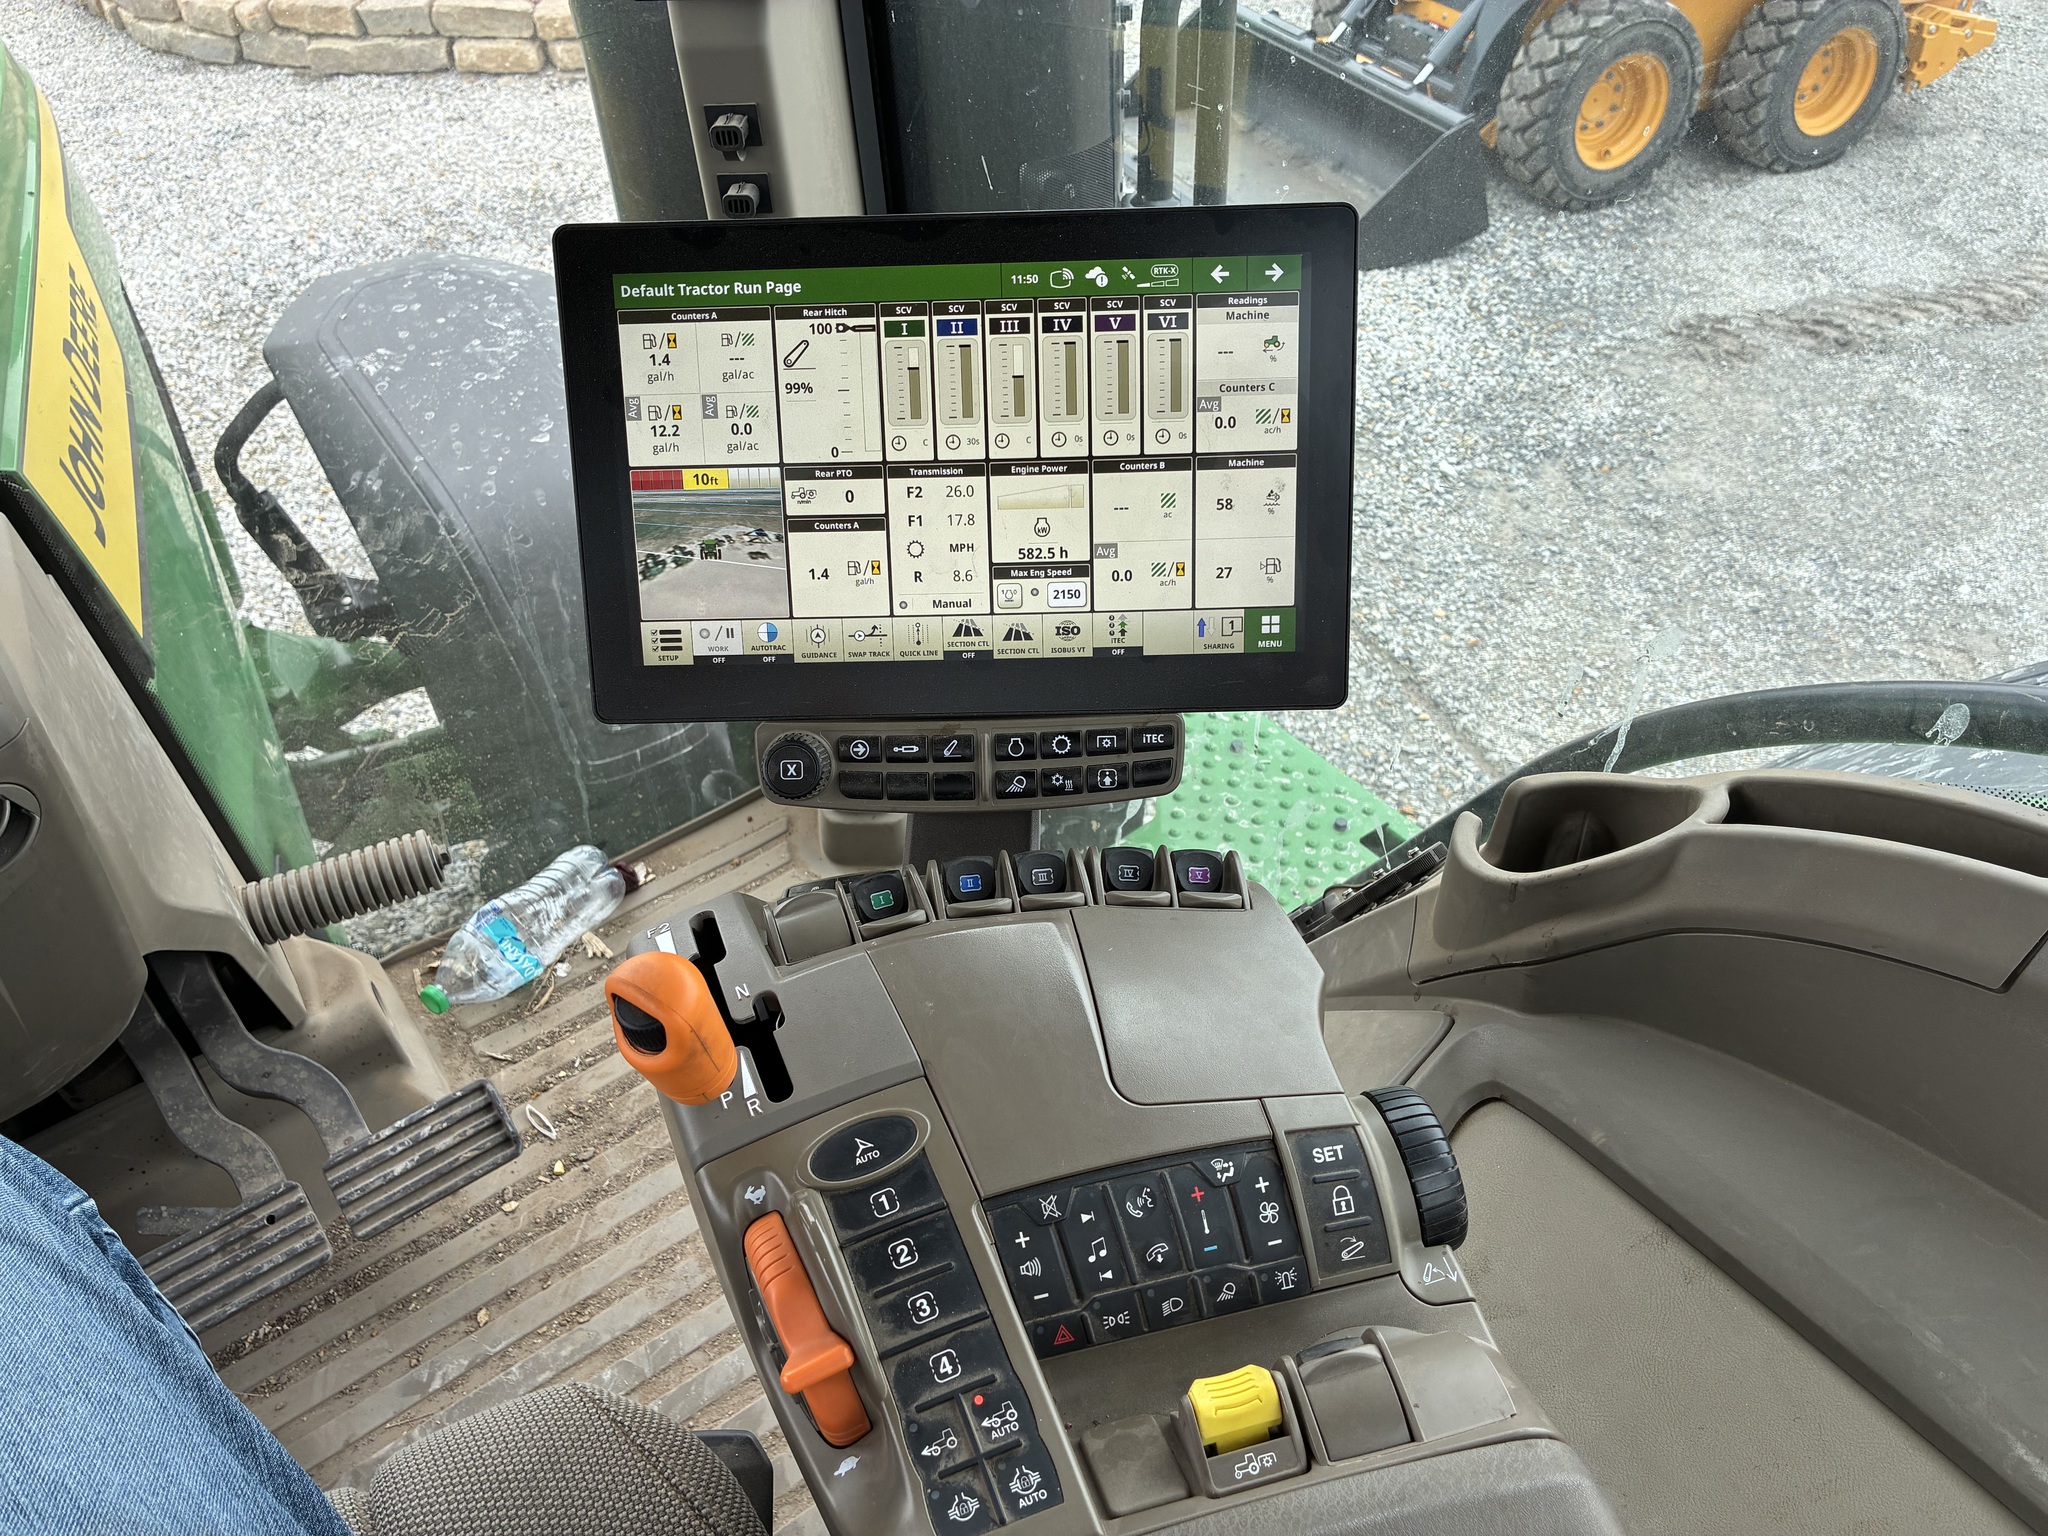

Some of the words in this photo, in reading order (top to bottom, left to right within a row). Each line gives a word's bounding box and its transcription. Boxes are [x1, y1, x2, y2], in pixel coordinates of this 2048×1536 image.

[1153, 266, 1176, 275] RTK-X
[1011, 275, 1039, 284] 11:50
[621, 284, 675, 297] Default
[678, 283, 730, 296] Tractor
[734, 282, 762, 294] Run
[766, 281, 802, 296] Page
[1001, 303, 1018, 311] SCV
[1054, 302, 1071, 310] SCV
[1107, 300, 1124, 308] SCV
[1160, 299, 1177, 307] SCV
[1228, 296, 1268, 306] Readings
[803, 308, 822, 317] Rear
[824, 307, 848, 316] Hitch
[896, 306, 912, 314] SCV
[948, 305, 965, 313] SCV
[671, 311, 708, 321] Counters
[710, 312, 718, 320] A
[1159, 315, 1178, 328] VI
[1226, 310, 1270, 321] Machine
[809, 323, 832, 335] 100
[901, 323, 908, 335] I
[951, 321, 964, 334] II
[1000, 320, 1020, 333] III
[1053, 318, 1072, 331] IV
[1109, 317, 1122, 329] V
[62, 262, 102, 414] DEERE
[649, 354, 671, 366] 1.4
[647, 371, 675, 385] gal/h
[722, 369, 755, 383] gal/ac
[785, 382, 814, 394] 99%
[1219, 383, 1266, 393] Counters
[1269, 382, 1276, 391] C
[627, 396, 639, 418] Avg
[704, 395, 716, 417] Avg
[1199, 399, 1219, 411] Avg
[1215, 416, 1236, 429] 0.0
[651, 425, 680, 437] 12.2
[731, 423, 753, 436] 0.0
[1264, 426, 1281, 434] ac/h
[967, 437, 980, 445] 30s
[1074, 434, 1083, 443] 0s
[1126, 433, 1135, 441] 0s
[1178, 432, 1187, 440] 0s
[652, 442, 680, 456] gal/h
[727, 440, 759, 454] gal/ac
[831, 447, 839, 458] 0
[59, 376, 106, 549] JOHN
[1120, 462, 1158, 471] Counters
[1229, 458, 1264, 467] Machine
[815, 469, 833, 478] Rear
[835, 469, 853, 477] PTO
[910, 467, 963, 476] Transmission
[1011, 466, 1039, 475] Engine
[1041, 465, 1068, 473] Power
[845, 490, 854, 503] 0
[907, 486, 923, 498] F2
[946, 484, 974, 498] 26.0
[1216, 498, 1233, 511] 58
[814, 521, 851, 531] Counters
[853, 522, 860, 530] A
[908, 515, 923, 527] F1
[947, 514, 975, 526] 17.8
[1037, 526, 1048, 534] kW
[949, 543, 975, 553] MPH
[1018, 547, 1056, 560] 582.5
[1060, 547, 1068, 559] h
[1096, 546, 1116, 559] Avg
[808, 568, 830, 580] 1.4
[914, 571, 923, 582] R
[953, 569, 974, 582] 8.6
[1011, 569, 1028, 577] Max
[1030, 569, 1044, 578] Eng
[1047, 568, 1072, 577] Speed
[1112, 569, 1133, 582] 0.0
[1216, 567, 1232, 579] 27
[855, 578, 875, 587] gal/h
[1159, 579, 1177, 587] ac/h
[1053, 589, 1081, 600] 2150
[932, 599, 972, 609] Manual
[1055, 625, 1081, 636] ISO
[1229, 620, 1235, 630] 1
[1203, 642, 1235, 650] SHARING
[1258, 640, 1283, 648] MENU
[713, 656, 726, 664] OFF
[801, 651, 837, 659] GUIDANCE
[869, 650, 891, 658] TRACK
[899, 650, 921, 658] QUICK
[1143, 732, 1165, 744] iTEC
[786, 764, 797, 776] X
[1038, 873, 1048, 881] III
[1124, 868, 1134, 878] IV
[1195, 871, 1203, 879] V
[966, 879, 974, 888] II
[879, 896, 885, 904] I
[501, 939, 535, 977] DASANI
[734, 983, 751, 1000] N
[720, 1091, 734, 1109] P
[746, 1098, 763, 1117] R
[855, 1149, 880, 1165] AUTO
[1312, 1145, 1344, 1163] SET
[878, 1195, 890, 1211] 1
[896, 1244, 911, 1264] 2
[915, 1298, 930, 1317] 3
[938, 1356, 953, 1375] 4
[990, 1421, 1019, 1440] AUTO
[1018, 1489, 1048, 1509] AUTO
